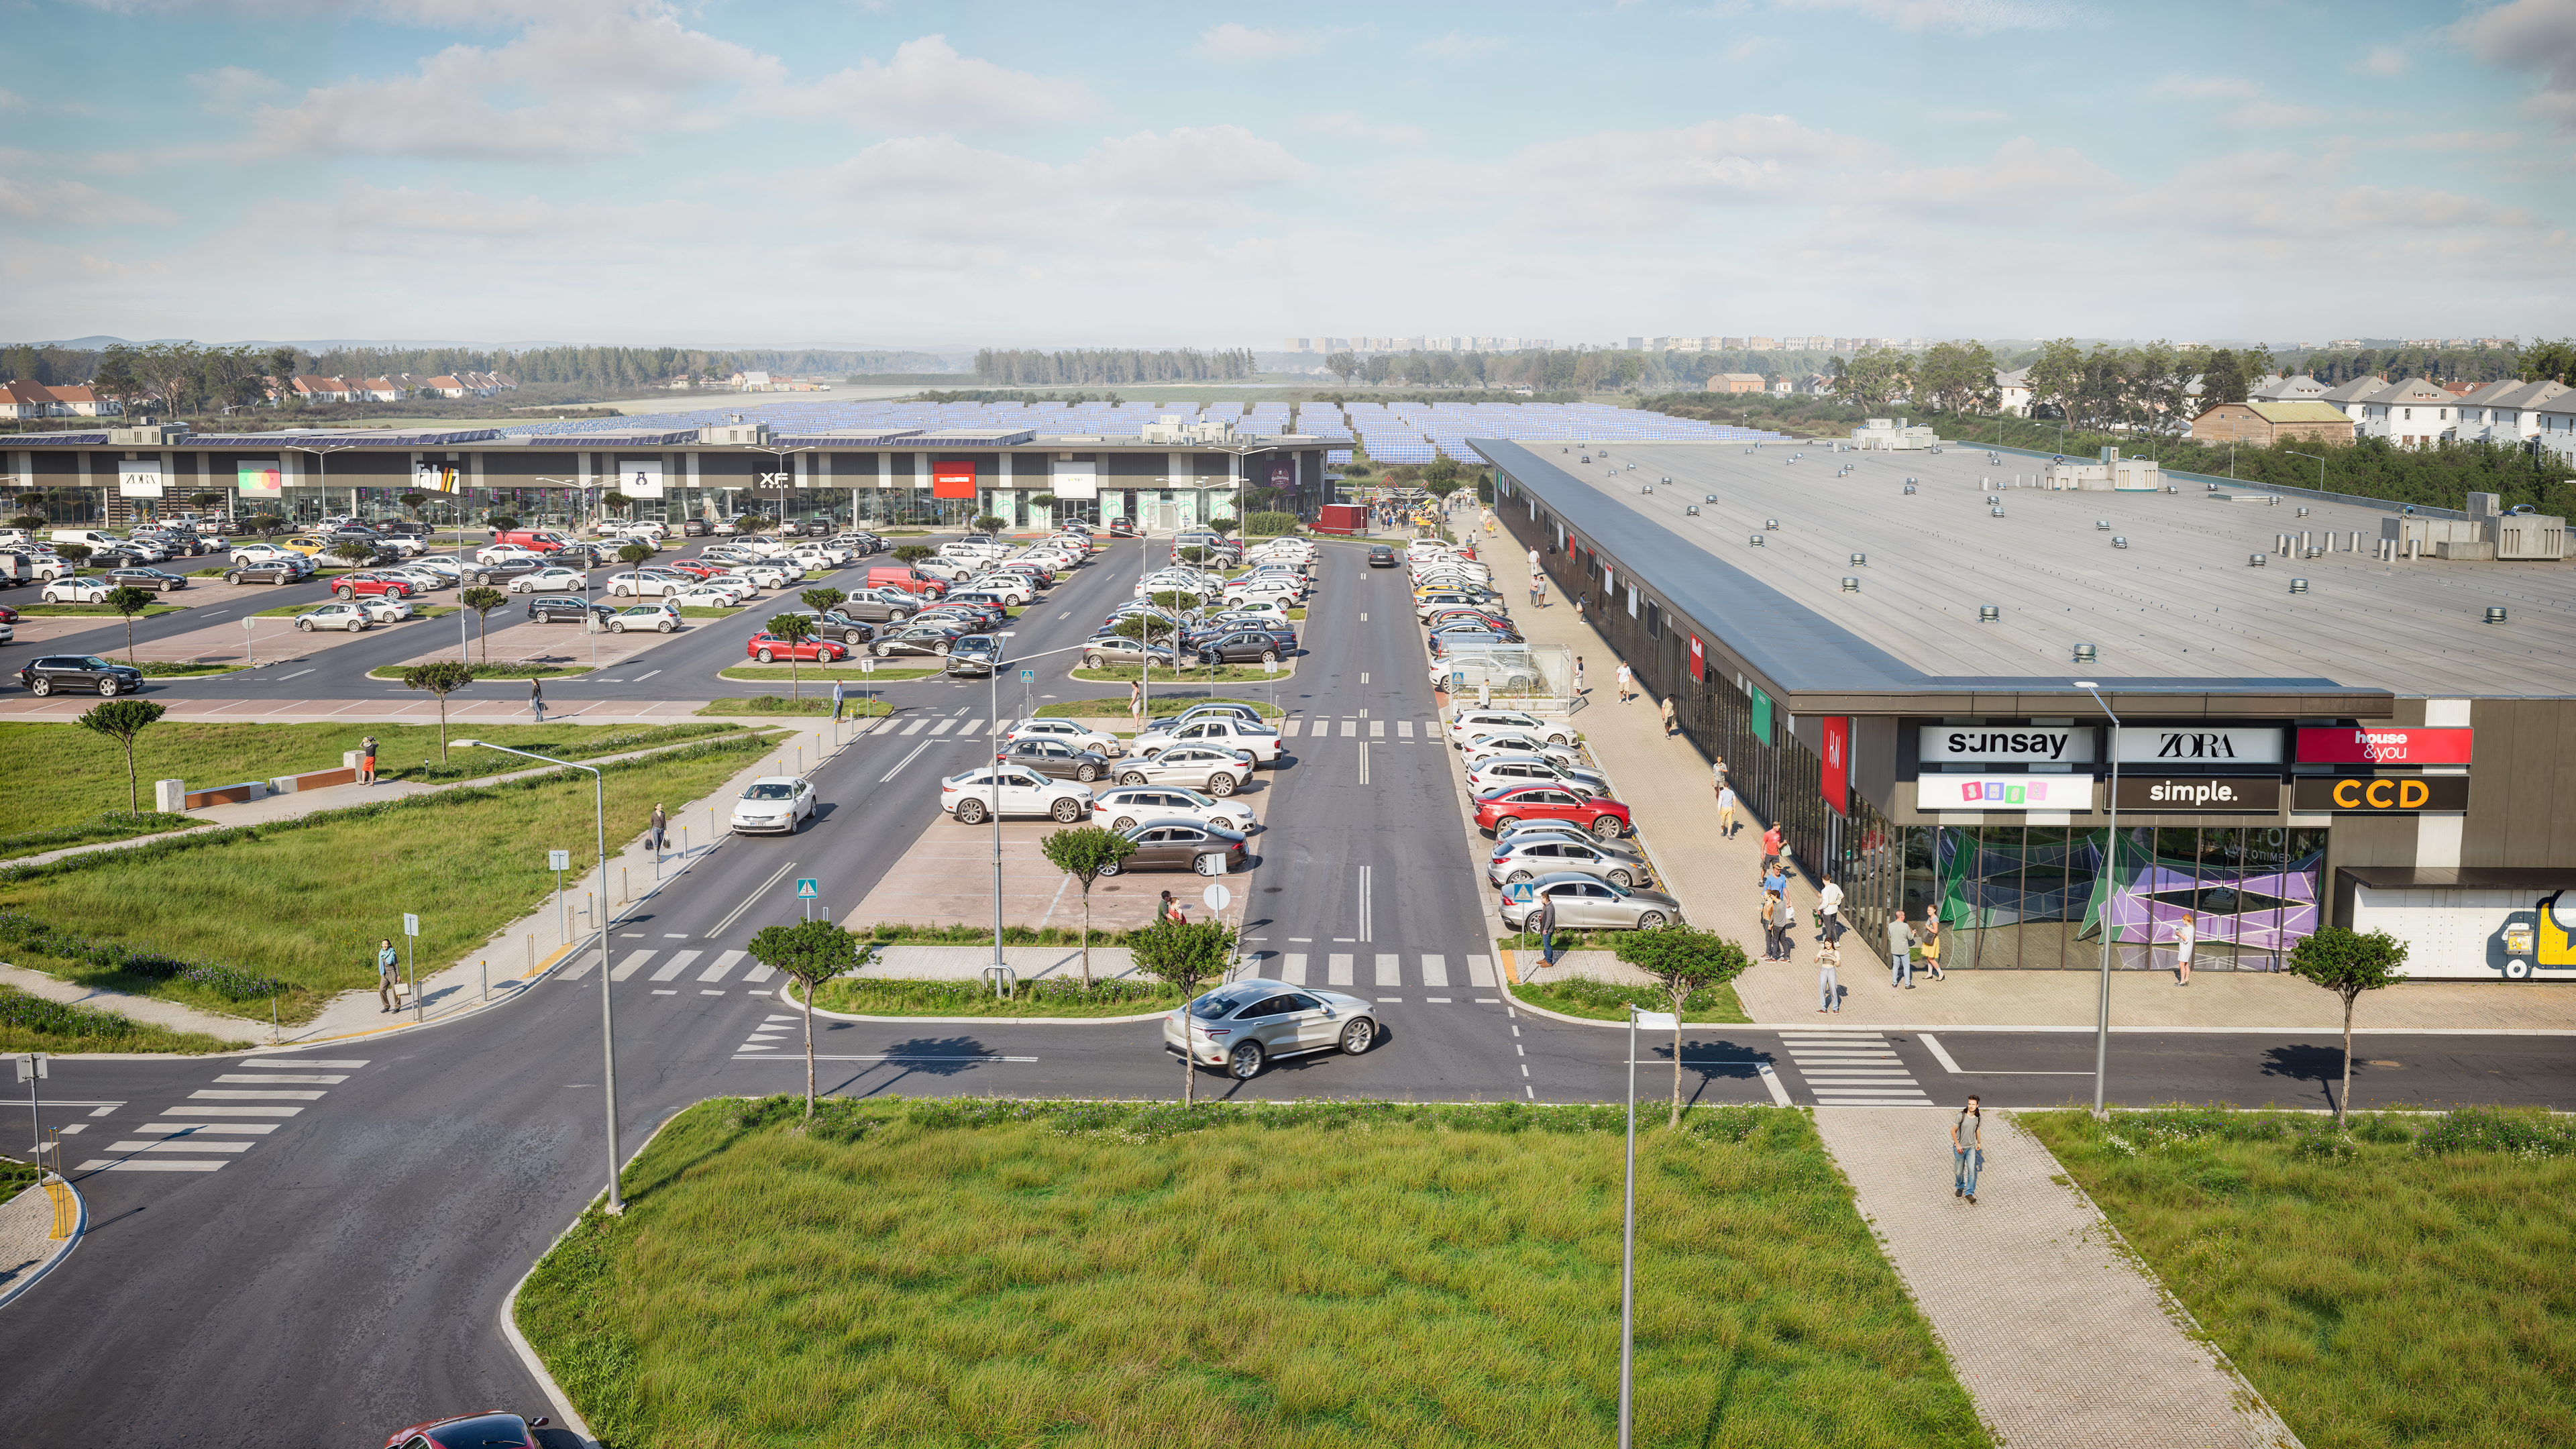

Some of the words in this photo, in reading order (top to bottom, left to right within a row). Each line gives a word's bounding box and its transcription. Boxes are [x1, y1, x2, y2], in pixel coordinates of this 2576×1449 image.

[126, 474, 157, 484] ZORA
[759, 472, 788, 484] XF
[1948, 733, 2069, 759] sunsay
[2157, 733, 2239, 759] ZORA
[2355, 731, 2408, 744] house
[2364, 744, 2406, 763] &you
[2149, 780, 2238, 806] simple.
[2332, 780, 2430, 808] CCD
